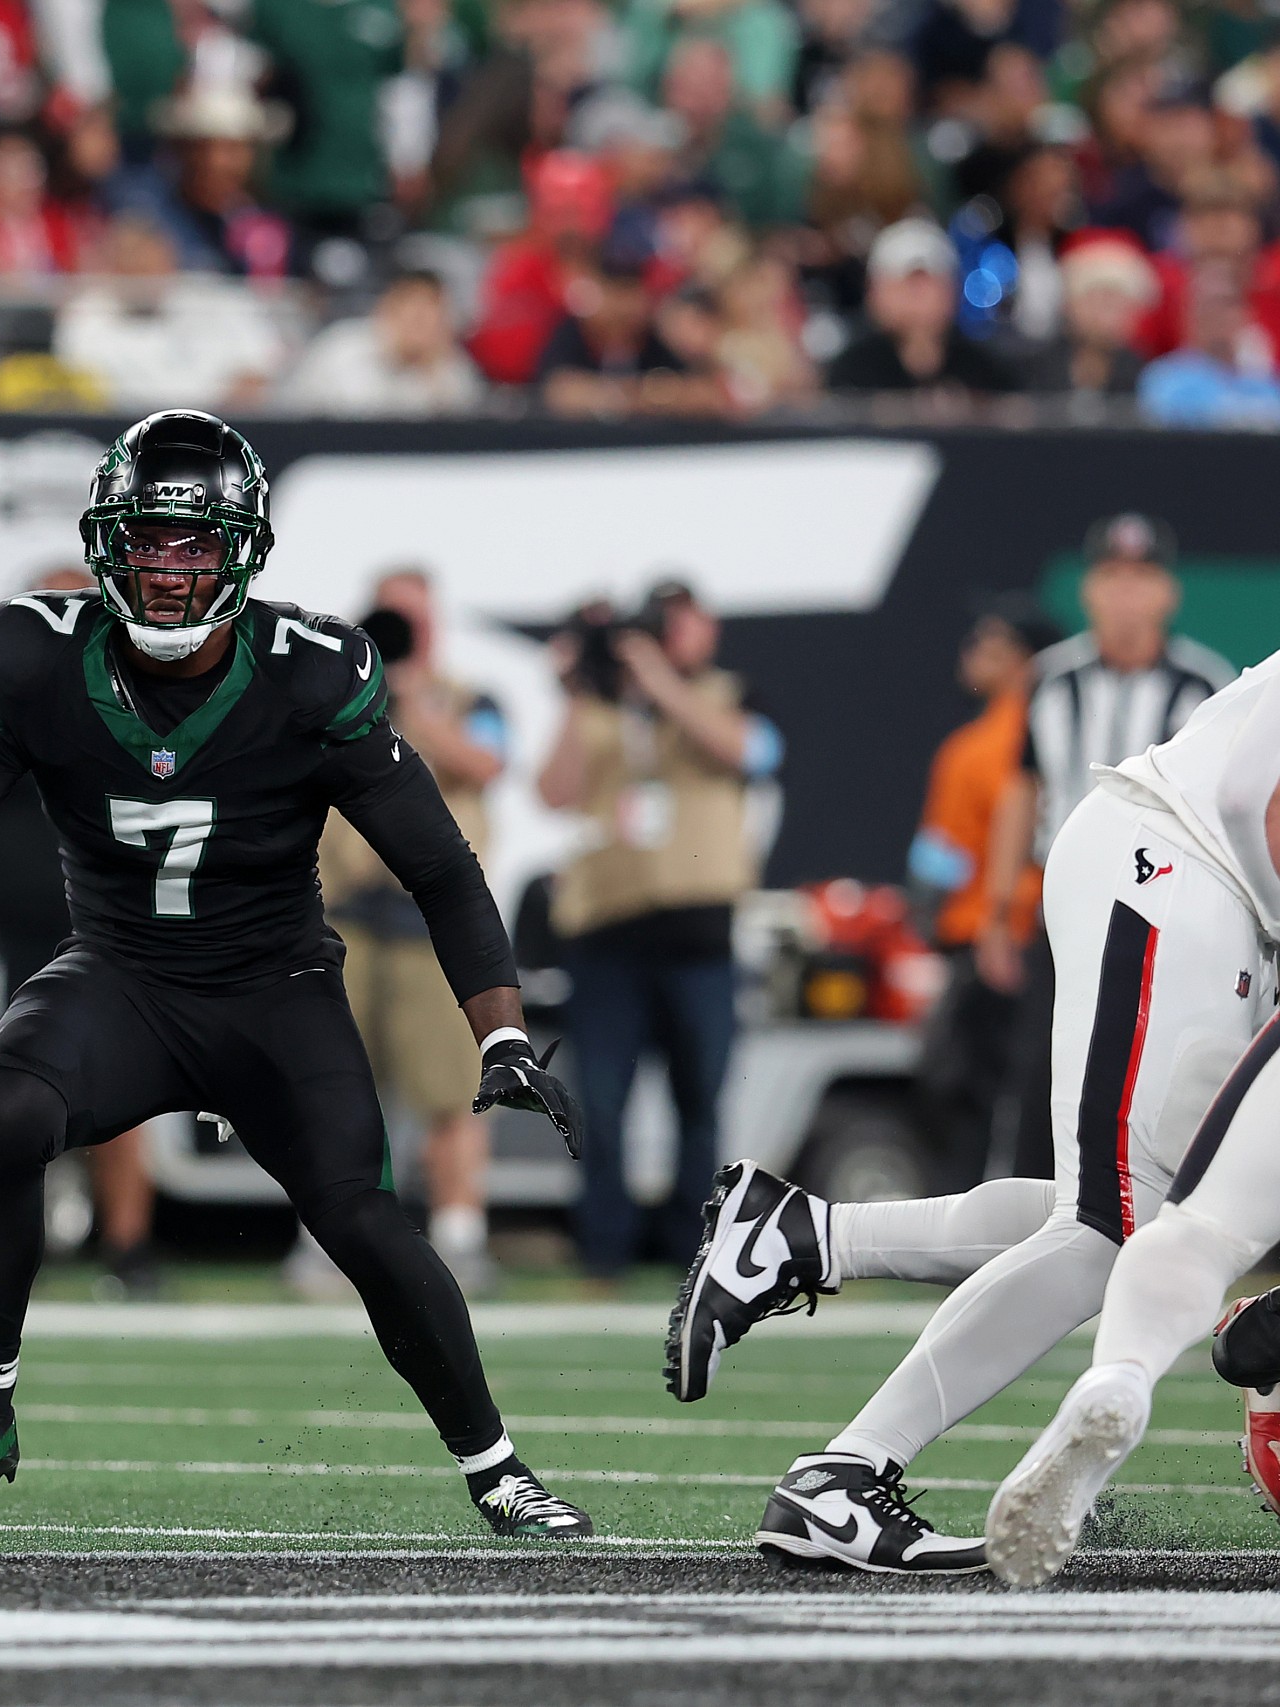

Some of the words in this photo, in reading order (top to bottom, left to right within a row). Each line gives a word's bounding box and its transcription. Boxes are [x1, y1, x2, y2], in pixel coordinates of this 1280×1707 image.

[269, 615, 345, 656] 7
[154, 762, 173, 774] NFL
[105, 793, 217, 919] 7
